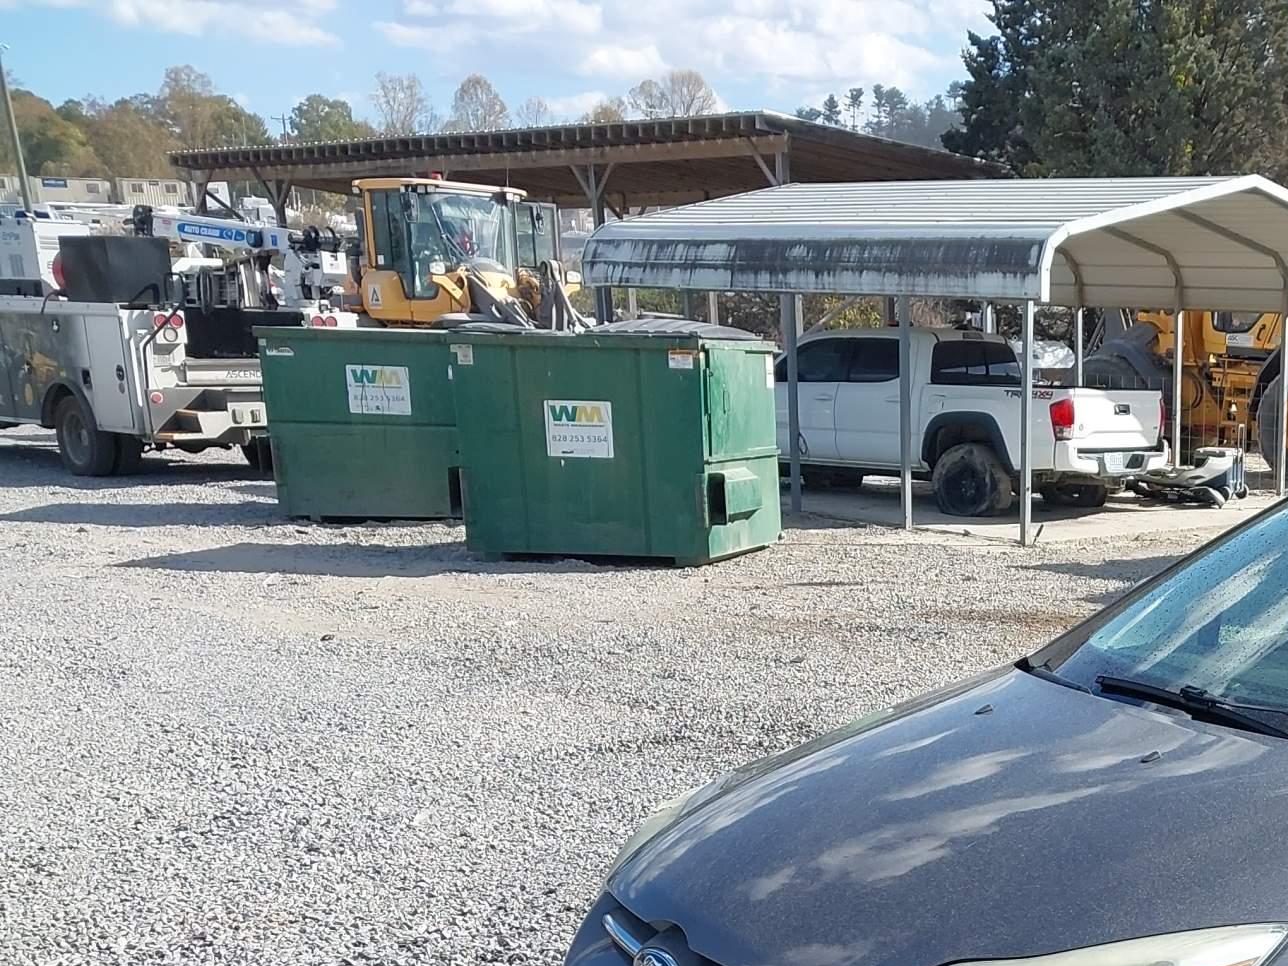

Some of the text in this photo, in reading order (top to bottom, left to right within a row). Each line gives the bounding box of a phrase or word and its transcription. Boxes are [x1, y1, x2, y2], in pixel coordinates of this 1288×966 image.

[350, 369, 402, 385] WM
[549, 405, 604, 422] WM
[552, 434, 567, 442] 828
